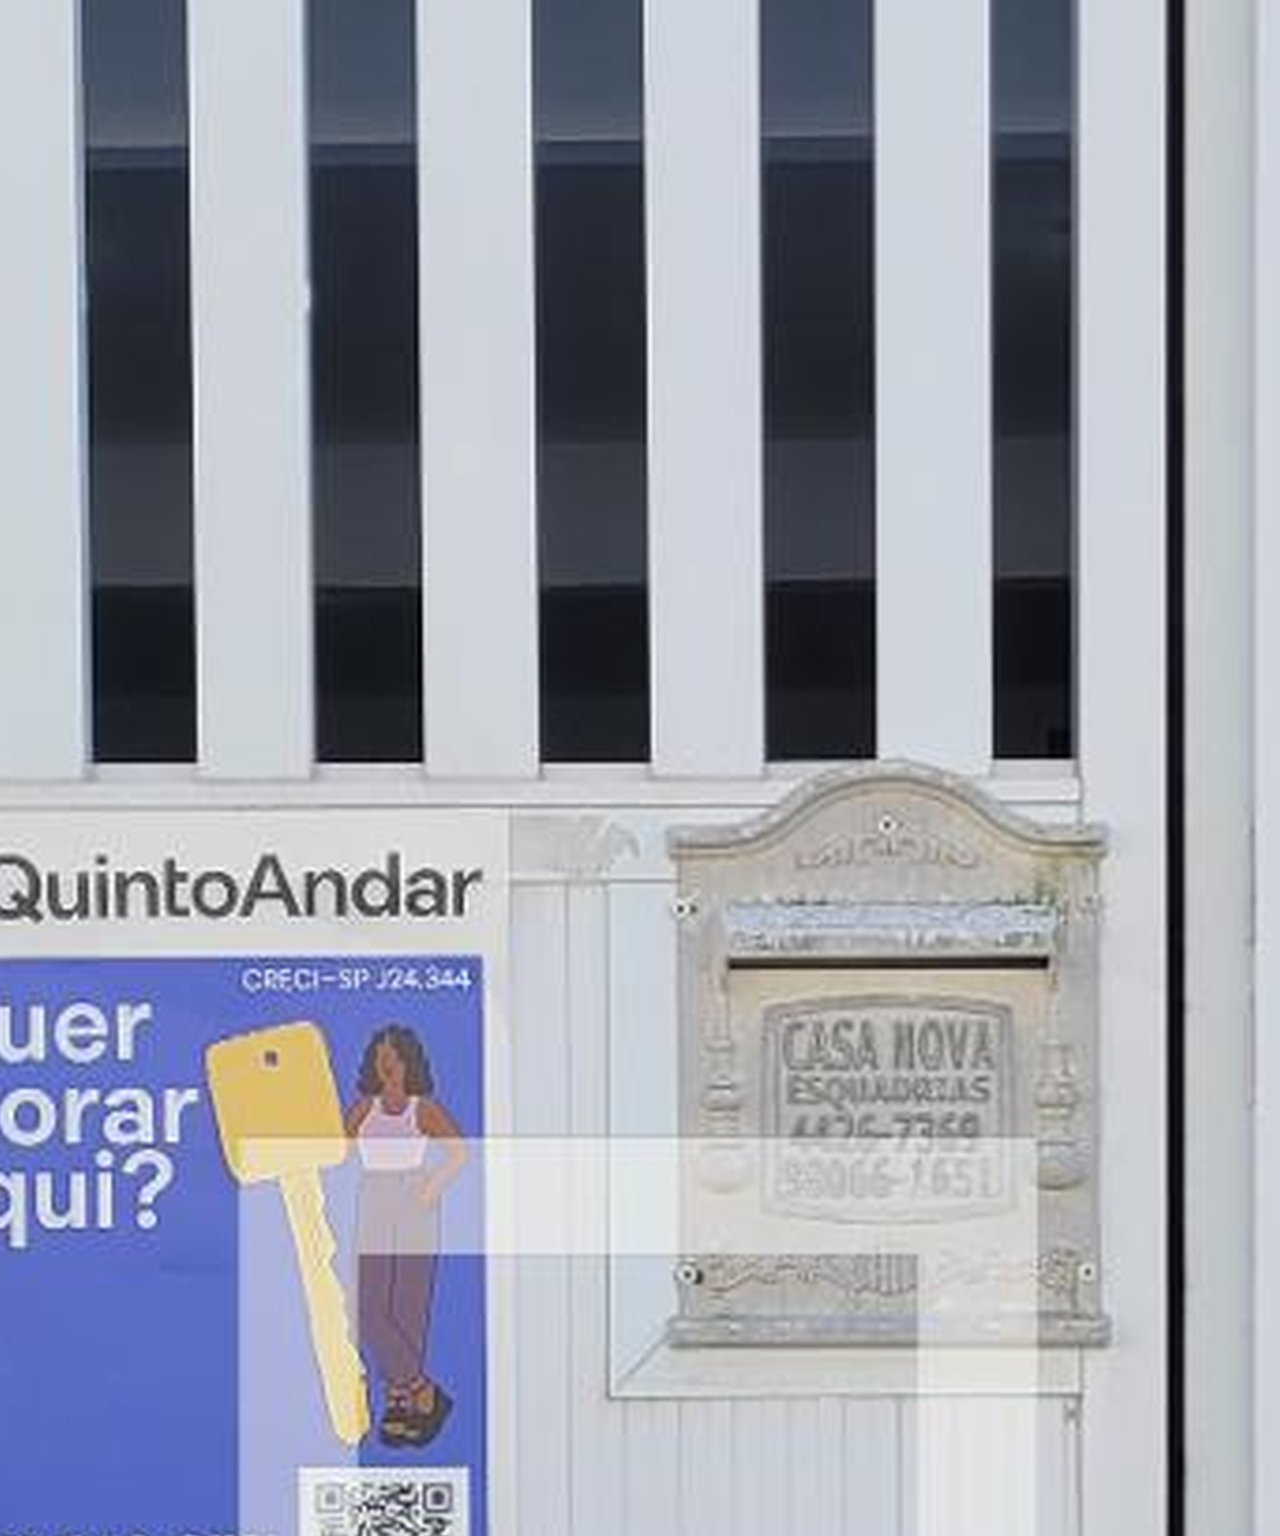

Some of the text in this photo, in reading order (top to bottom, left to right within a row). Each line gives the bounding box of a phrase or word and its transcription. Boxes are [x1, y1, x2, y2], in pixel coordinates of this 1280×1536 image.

[241, 967, 372, 993] CRECI-SP
[782, 1019, 995, 1072] CASA NOVA
[786, 1075, 993, 1112] ESQUADRIAS
